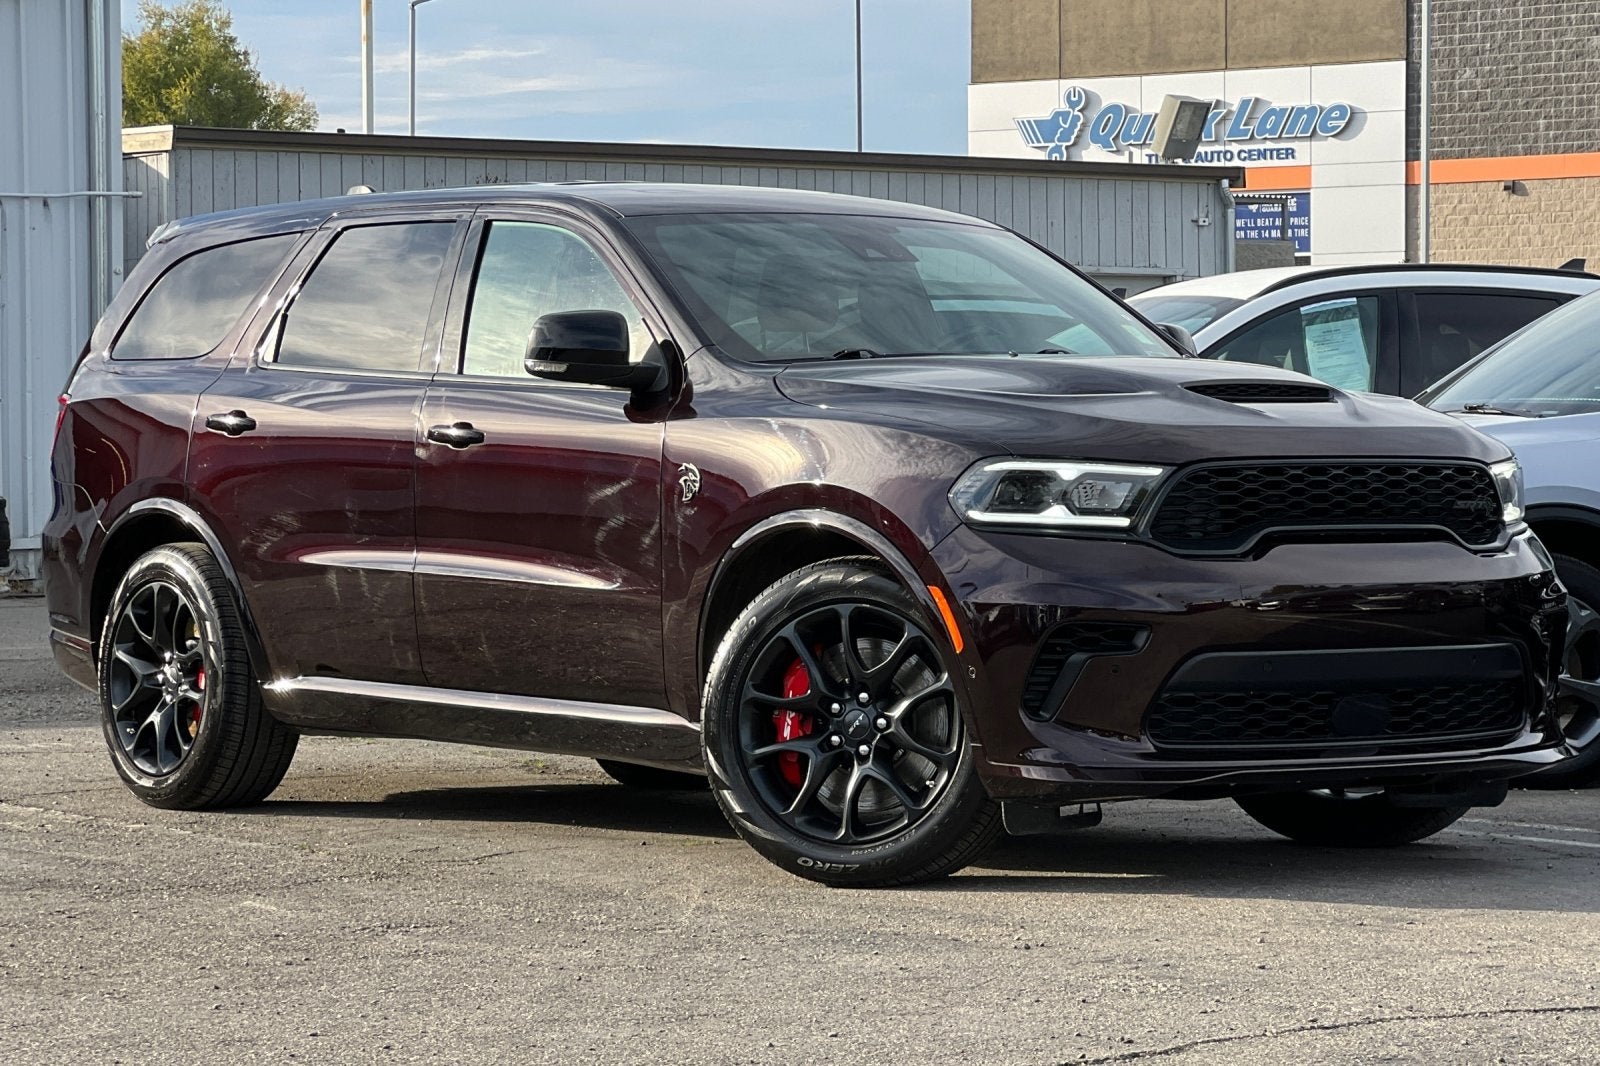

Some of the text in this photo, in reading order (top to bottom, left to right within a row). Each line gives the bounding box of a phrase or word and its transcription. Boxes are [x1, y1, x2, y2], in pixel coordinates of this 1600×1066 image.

[1089, 97, 1351, 151] Quk Lane
[1195, 149, 1234, 163] AUTO
[1236, 147, 1295, 161] CENTER
[1236, 218, 1255, 227] WE'LL
[1257, 217, 1273, 227] BEAT
[1290, 216, 1309, 226] PRICE
[1236, 228, 1309, 239] ON THE 14 MAR TIRE
[797, 856, 860, 873] ZERO
